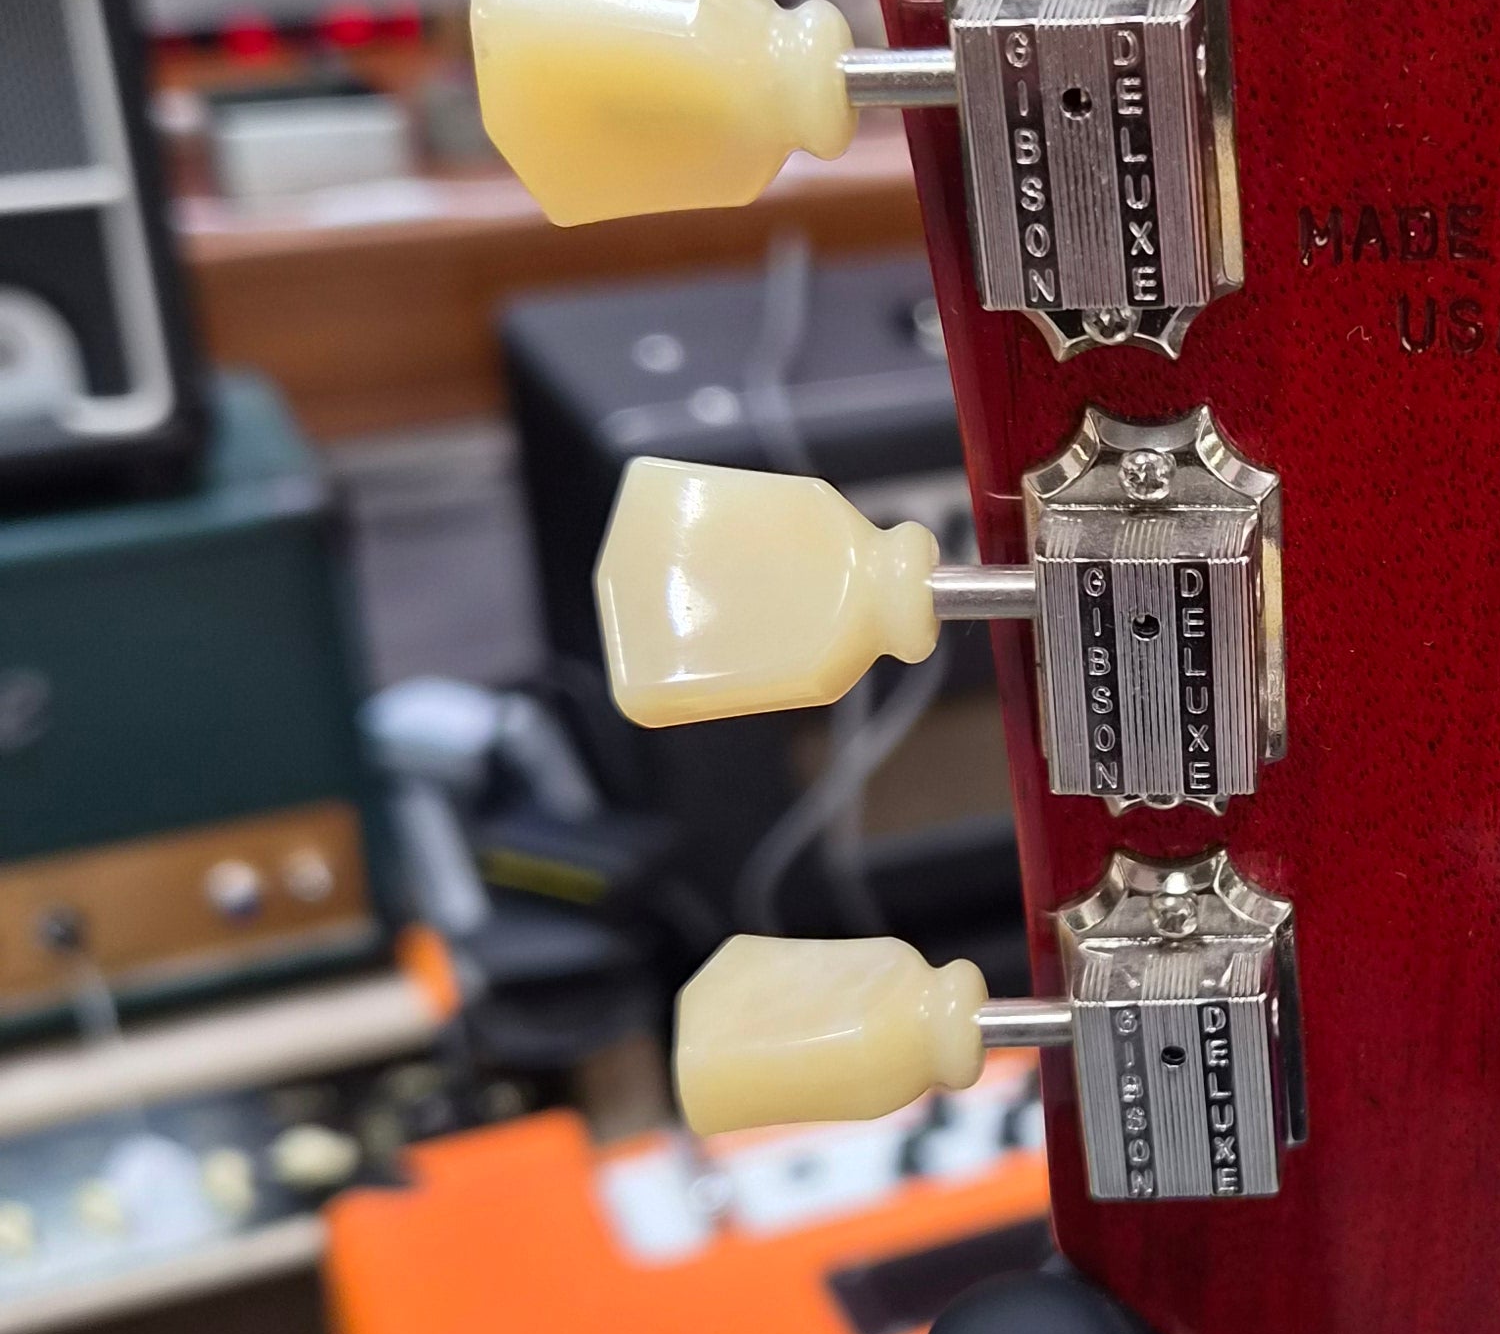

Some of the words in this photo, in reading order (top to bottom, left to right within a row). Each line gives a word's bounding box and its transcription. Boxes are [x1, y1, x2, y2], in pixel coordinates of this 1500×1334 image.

[1004, 30, 1056, 304] GIBSON
[1111, 29, 1158, 302] DELUXE
[1298, 204, 1489, 265] MADE
[1083, 568, 1118, 790] GIBSON
[1179, 567, 1211, 790] DELUXE
[1114, 1007, 1155, 1197] GIBSON
[1202, 1006, 1239, 1196] DELUXE
